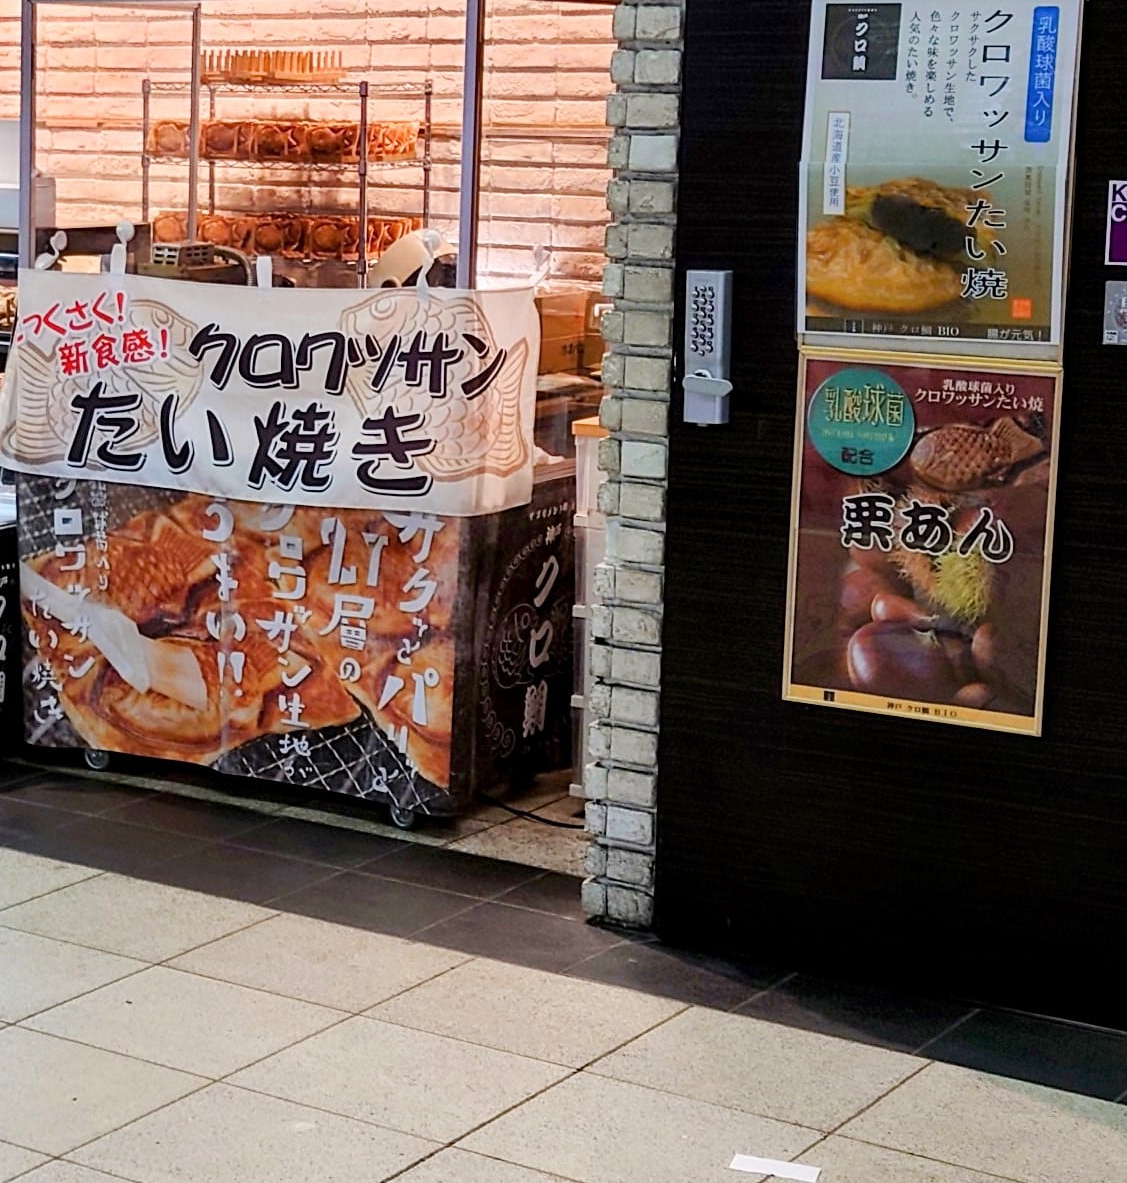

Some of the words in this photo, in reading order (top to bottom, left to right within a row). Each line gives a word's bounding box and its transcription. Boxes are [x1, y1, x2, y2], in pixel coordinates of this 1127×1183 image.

[923, 10, 941, 118] 色々な味を楽しめる
[966, 11, 981, 83] サクサクした
[1032, 17, 1057, 127] 乳酸球菌入り
[960, 9, 1014, 300] クロワッサンたい焼
[17, 292, 124, 342] っくさく!
[59, 328, 168, 376] 新食感!
[188, 323, 506, 399] クロワッサン
[943, 378, 1016, 395] 乳酸球菌入り
[825, 383, 905, 428] 乳酸球菌
[914, 388, 1044, 413] クロワッサンたい焼
[66, 381, 438, 496] たい焼き
[840, 446, 875, 465] 配合
[840, 493, 1016, 564] 栗あん
